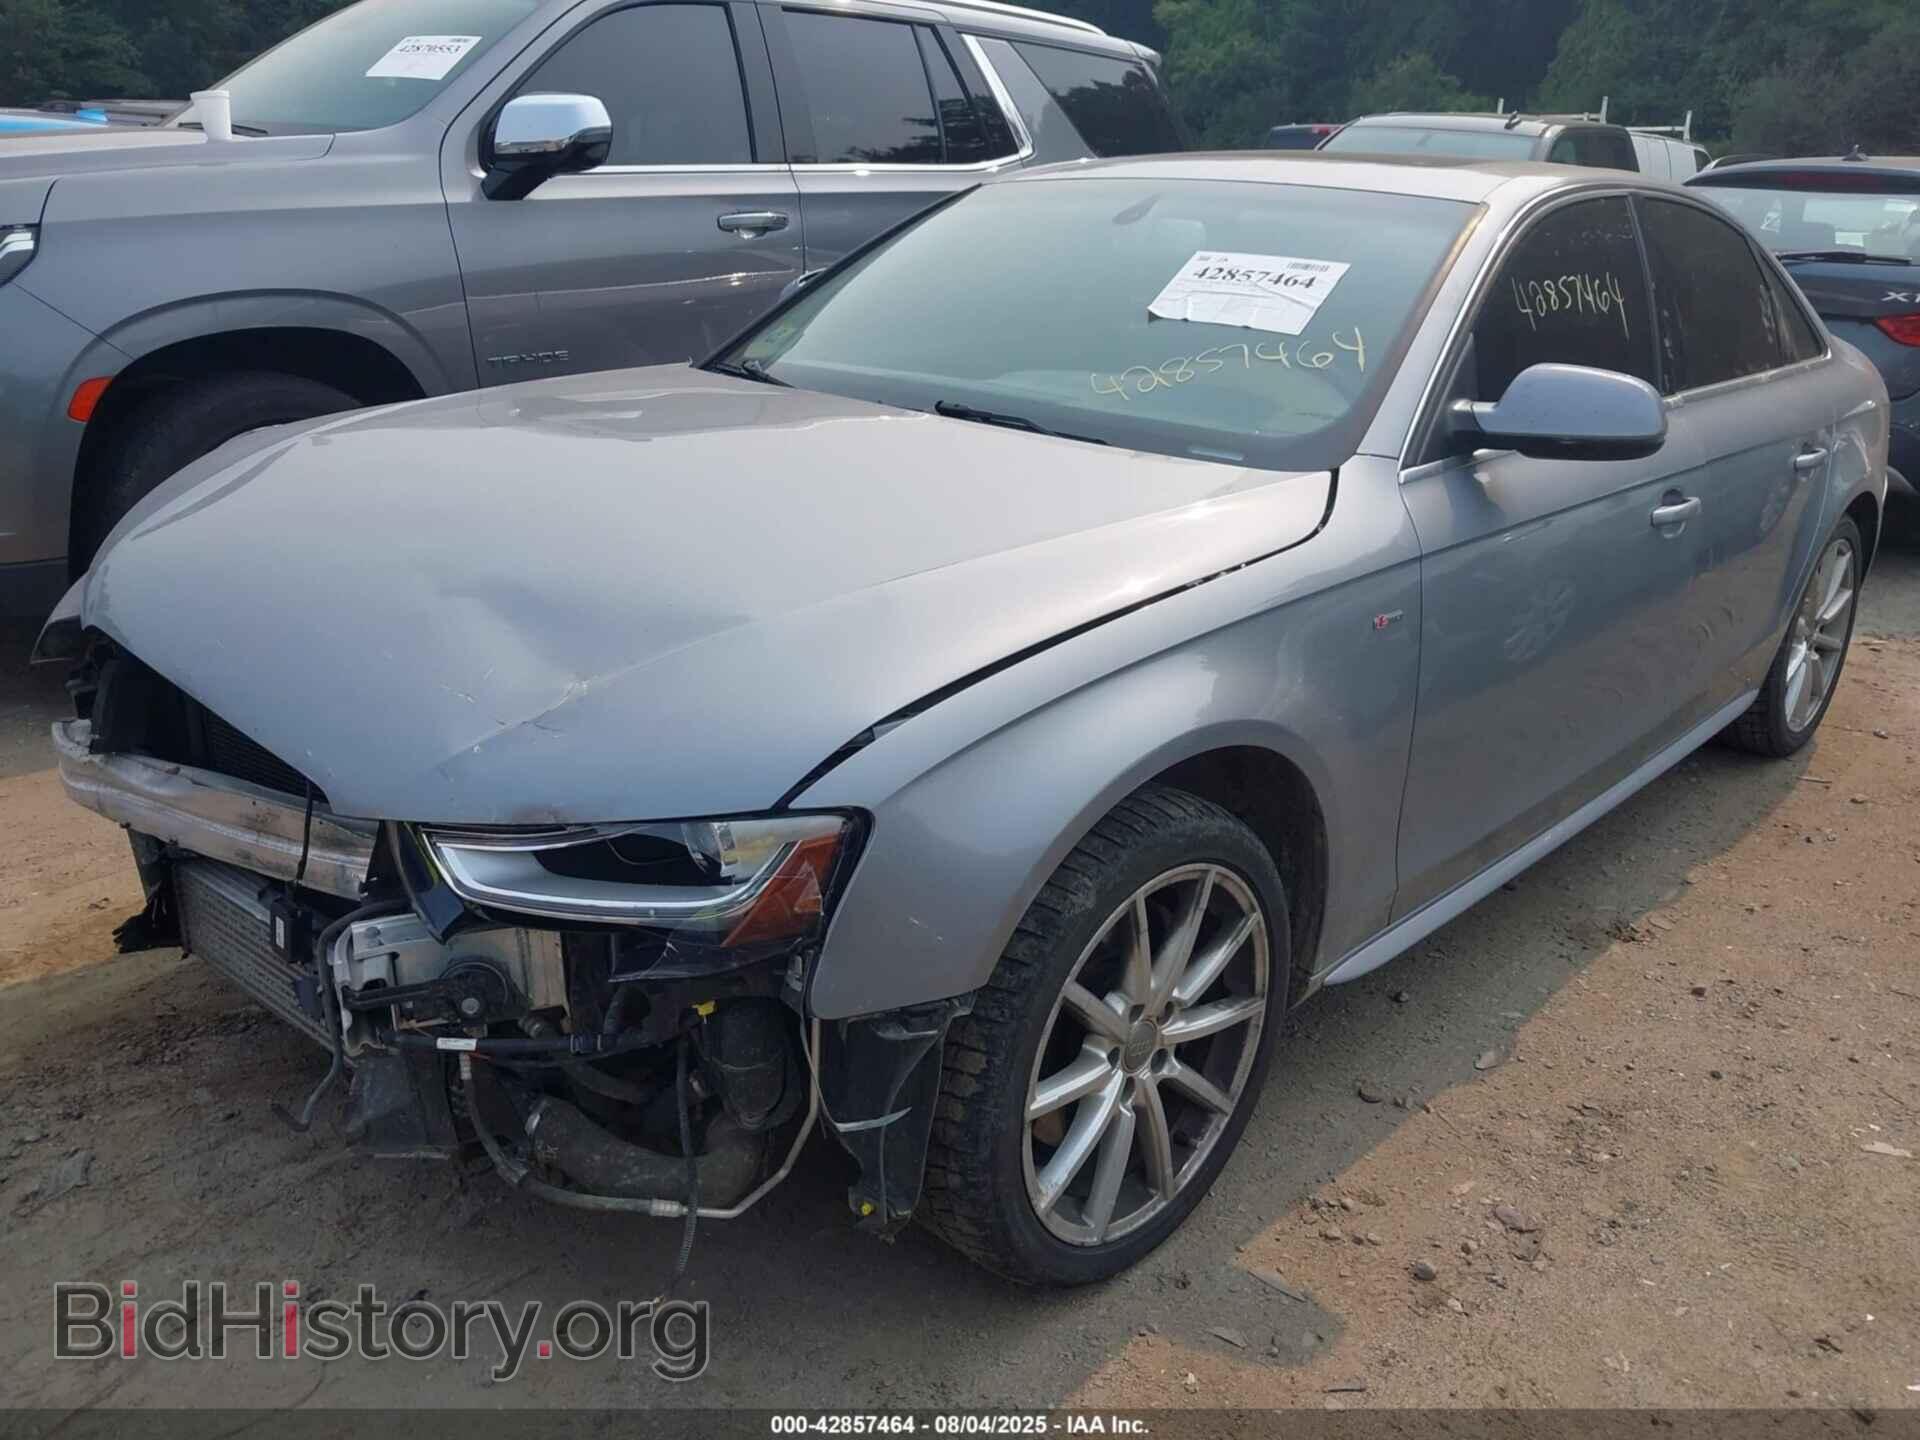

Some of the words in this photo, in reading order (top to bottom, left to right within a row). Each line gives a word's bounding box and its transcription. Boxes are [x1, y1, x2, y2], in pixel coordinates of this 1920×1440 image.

[1193, 266, 1316, 289] 42857464
[1511, 271, 1630, 341] 42857464
[1090, 326, 1366, 401] 42857464
